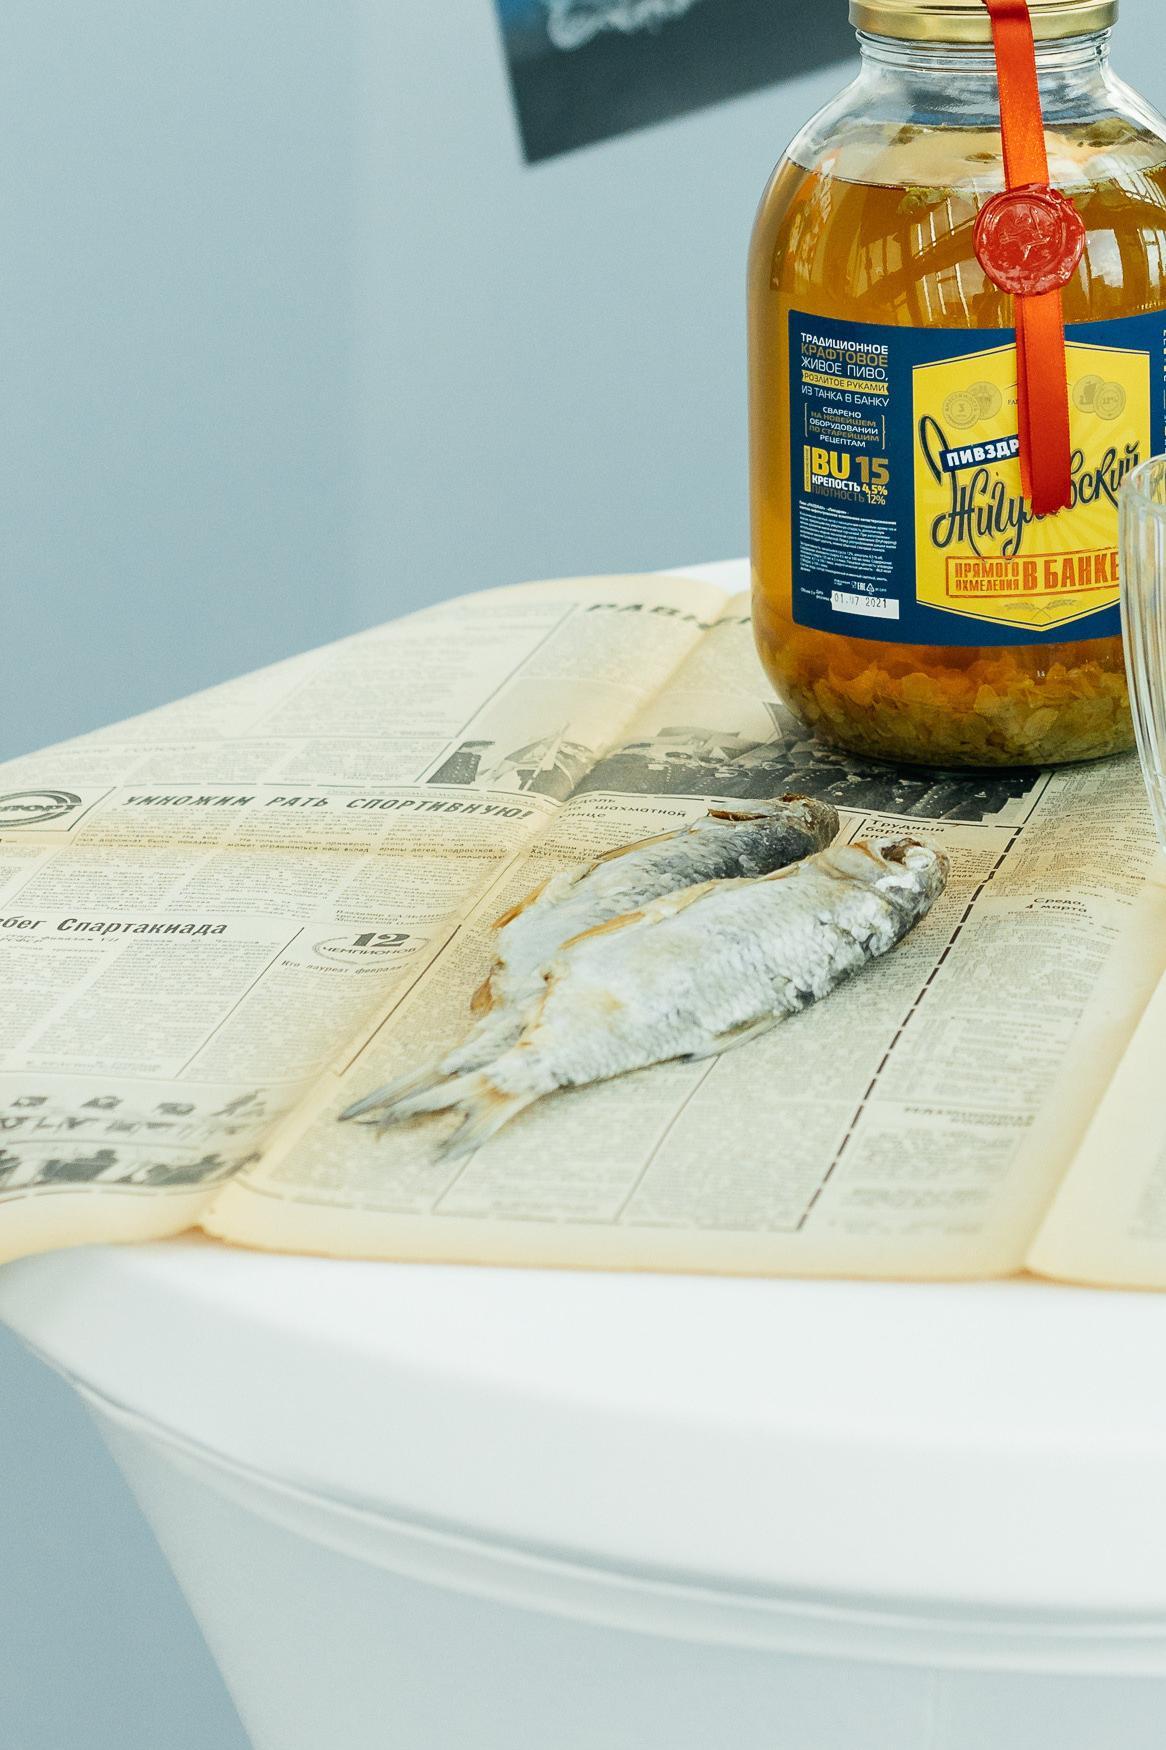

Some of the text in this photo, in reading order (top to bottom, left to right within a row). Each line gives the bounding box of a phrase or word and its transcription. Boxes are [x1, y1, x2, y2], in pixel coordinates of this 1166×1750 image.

[801, 332, 888, 354] ТРАДИЦИОННОЕ
[801, 343, 888, 367] КРАФТОВОЕ
[801, 356, 888, 381] ЖИВОЕ ПИВО,
[804, 372, 885, 392] РОЗЛИТОЕ РУКАМИ
[802, 385, 889, 406] ИЗ ТАНКА В БАНКУ
[822, 407, 861, 418] СВАРЕНО
[824, 414, 876, 427] НОВЕЙШЕМ
[810, 418, 878, 434] ОБОРУДОВАНИИ
[822, 427, 879, 441] СТАРЕЙШИМ
[820, 435, 866, 447] РЕЦЕПТАМ
[855, 456, 889, 485] 15
[812, 474, 888, 496] КРЕПОСТЬ 4,5%
[918, 414, 1140, 562] Жигувский
[811, 484, 886, 505] ПЛОТНОСТЬ 12%
[955, 561, 1020, 579] ПРЯМОГО
[1023, 560, 1038, 591] В
[955, 578, 1020, 593] ОХМЕЛЕНИЯ
[865, 596, 887, 609] 2021
[122, 795, 535, 820] УМНОЖИМ РАТЬ СПОРТИВНУЮ!
[595, 805, 687, 818] шахматной
[871, 819, 945, 832] Трудный
[1034, 898, 1086, 907] Среда,
[1040, 904, 1087, 913] марта
[0, 916, 228, 936] бег Спартакиада
[352, 933, 411, 947] 12
[323, 946, 417, 955] ЧЕМПИОНОВ
